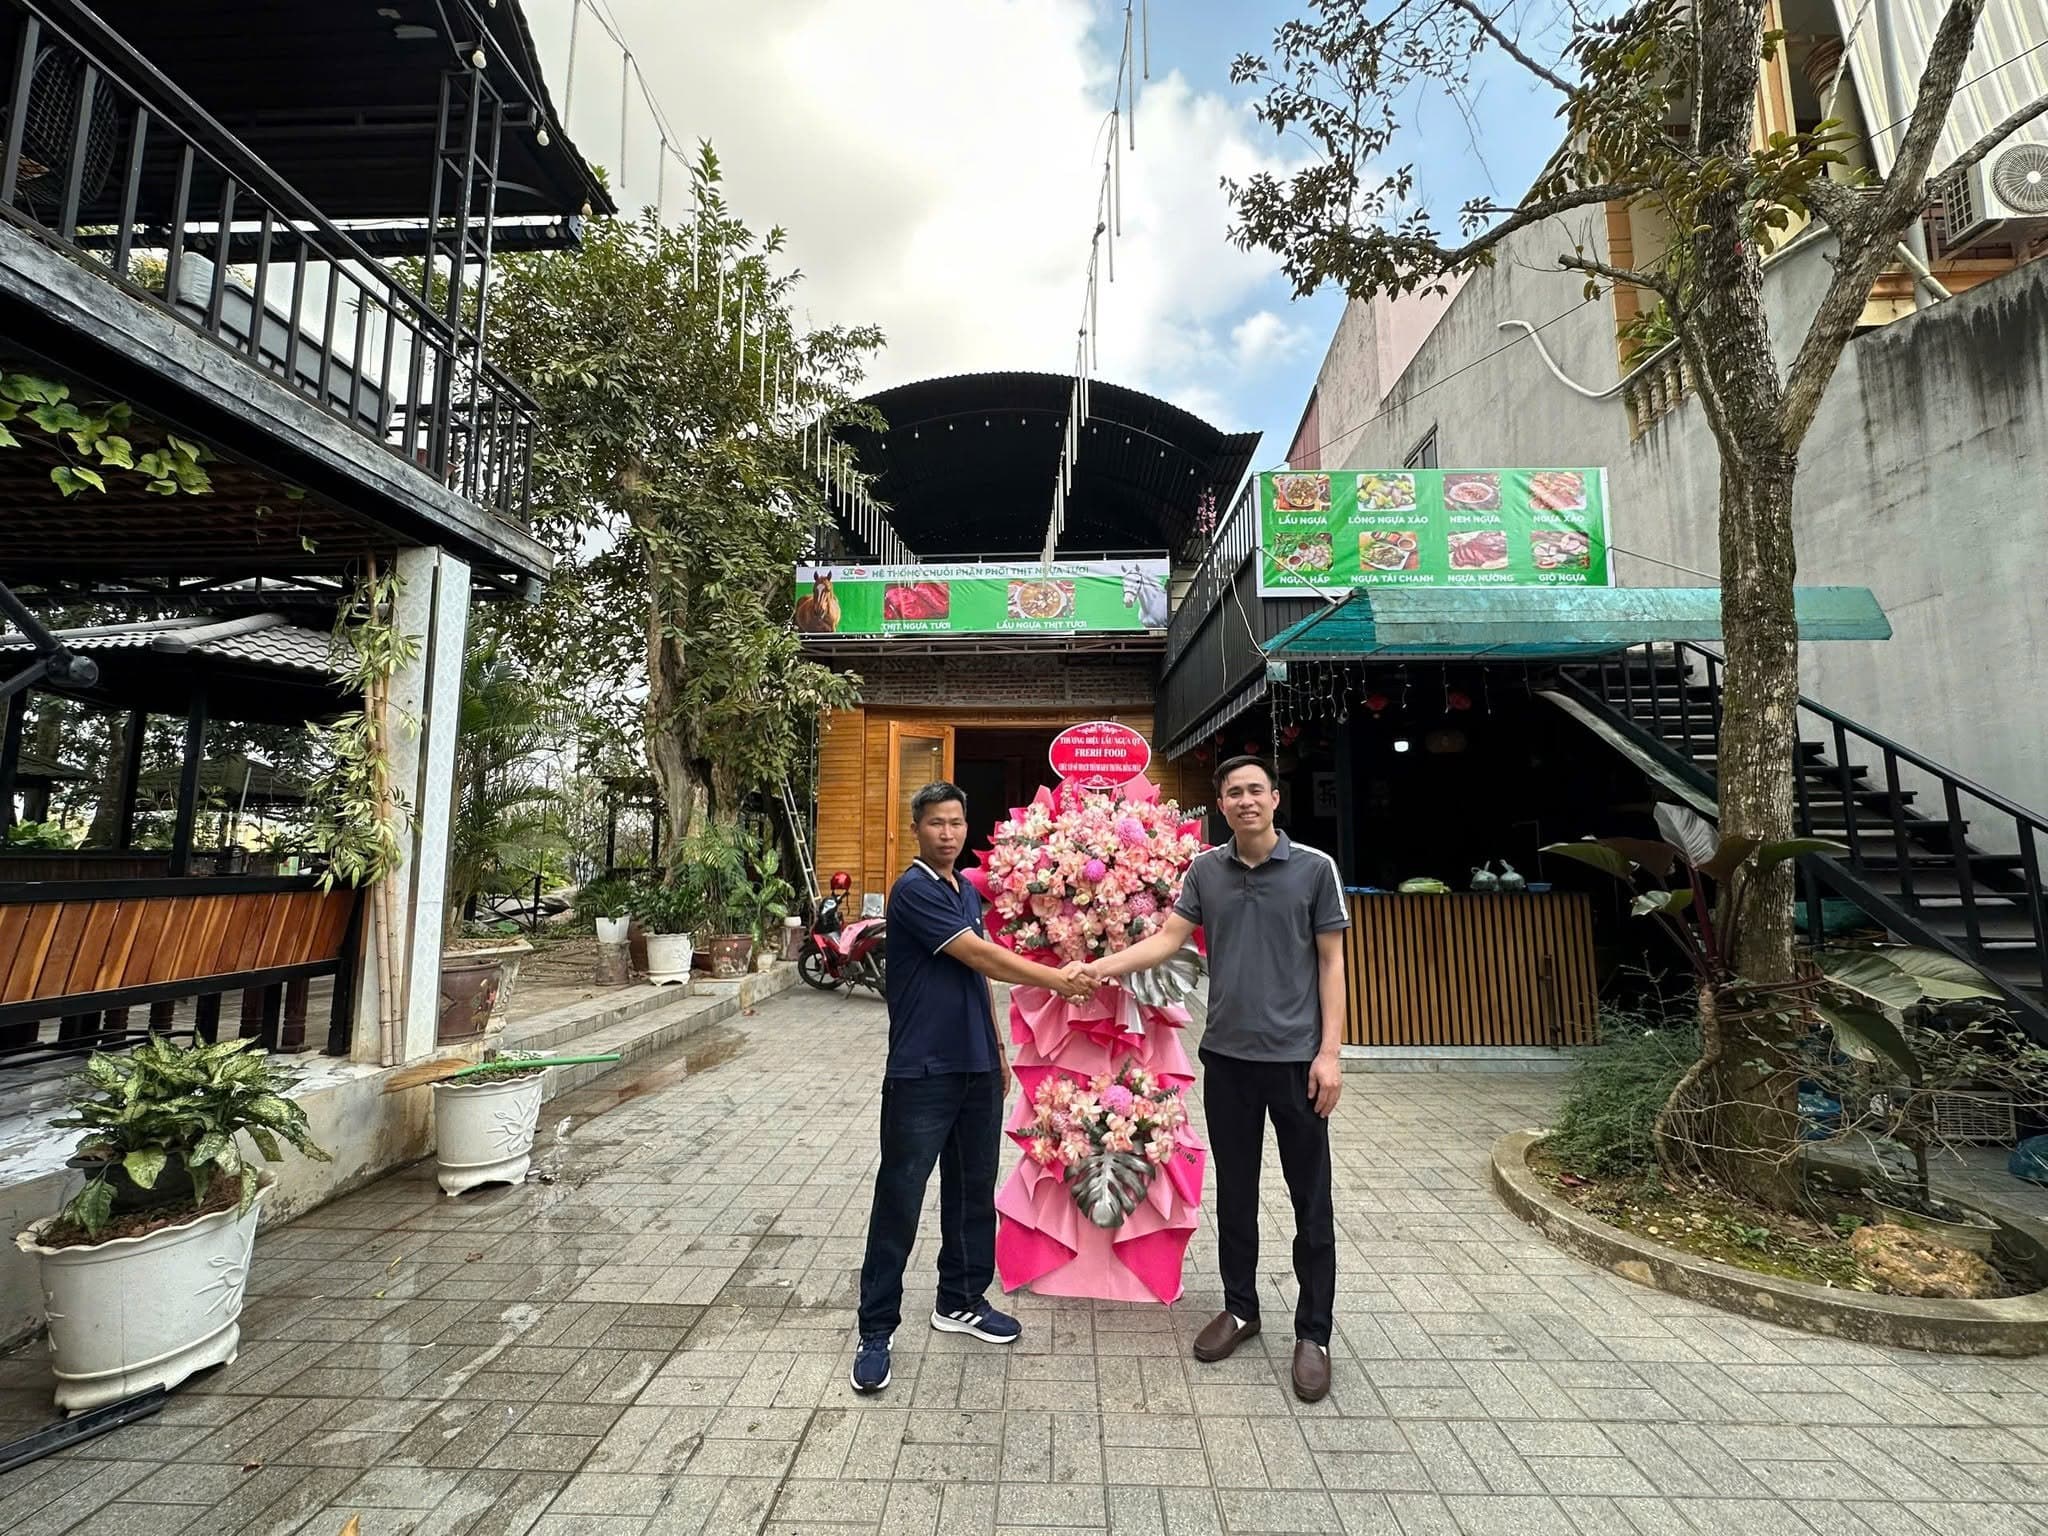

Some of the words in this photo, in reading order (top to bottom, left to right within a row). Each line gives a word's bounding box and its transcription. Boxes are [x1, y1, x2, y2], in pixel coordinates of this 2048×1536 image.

[1300, 516, 1328, 526] NGỰA
[1348, 516, 1375, 524] LÒNG
[1378, 516, 1404, 525] NGỰA
[1408, 514, 1428, 524] XÀO
[1473, 516, 1500, 524] NGỰA
[1533, 516, 1560, 524] NGỰA
[1564, 514, 1585, 522] XÀO
[872, 568, 886, 578] HỆ
[956, 564, 983, 576] PHÂN
[985, 564, 1009, 576] PHỐI
[1010, 567, 1032, 576] THỊT
[1312, 573, 1330, 584] HẤP
[1351, 576, 1378, 584] NGỰA
[1381, 573, 1397, 582] TÁI
[1448, 574, 1476, 584] NGỰA
[1478, 572, 1514, 582] NƯỚNG
[1538, 573, 1556, 582] GIÒ
[1559, 574, 1586, 583] NGỰA
[882, 623, 902, 632] THỊT
[903, 622, 928, 632] NGỰA
[931, 622, 951, 630] TƯƠI
[1016, 620, 1041, 630] NGỰA
[1043, 620, 1064, 630] THỊT
[1065, 620, 1088, 628] TƯƠI
[1104, 748, 1126, 758] FOOD
